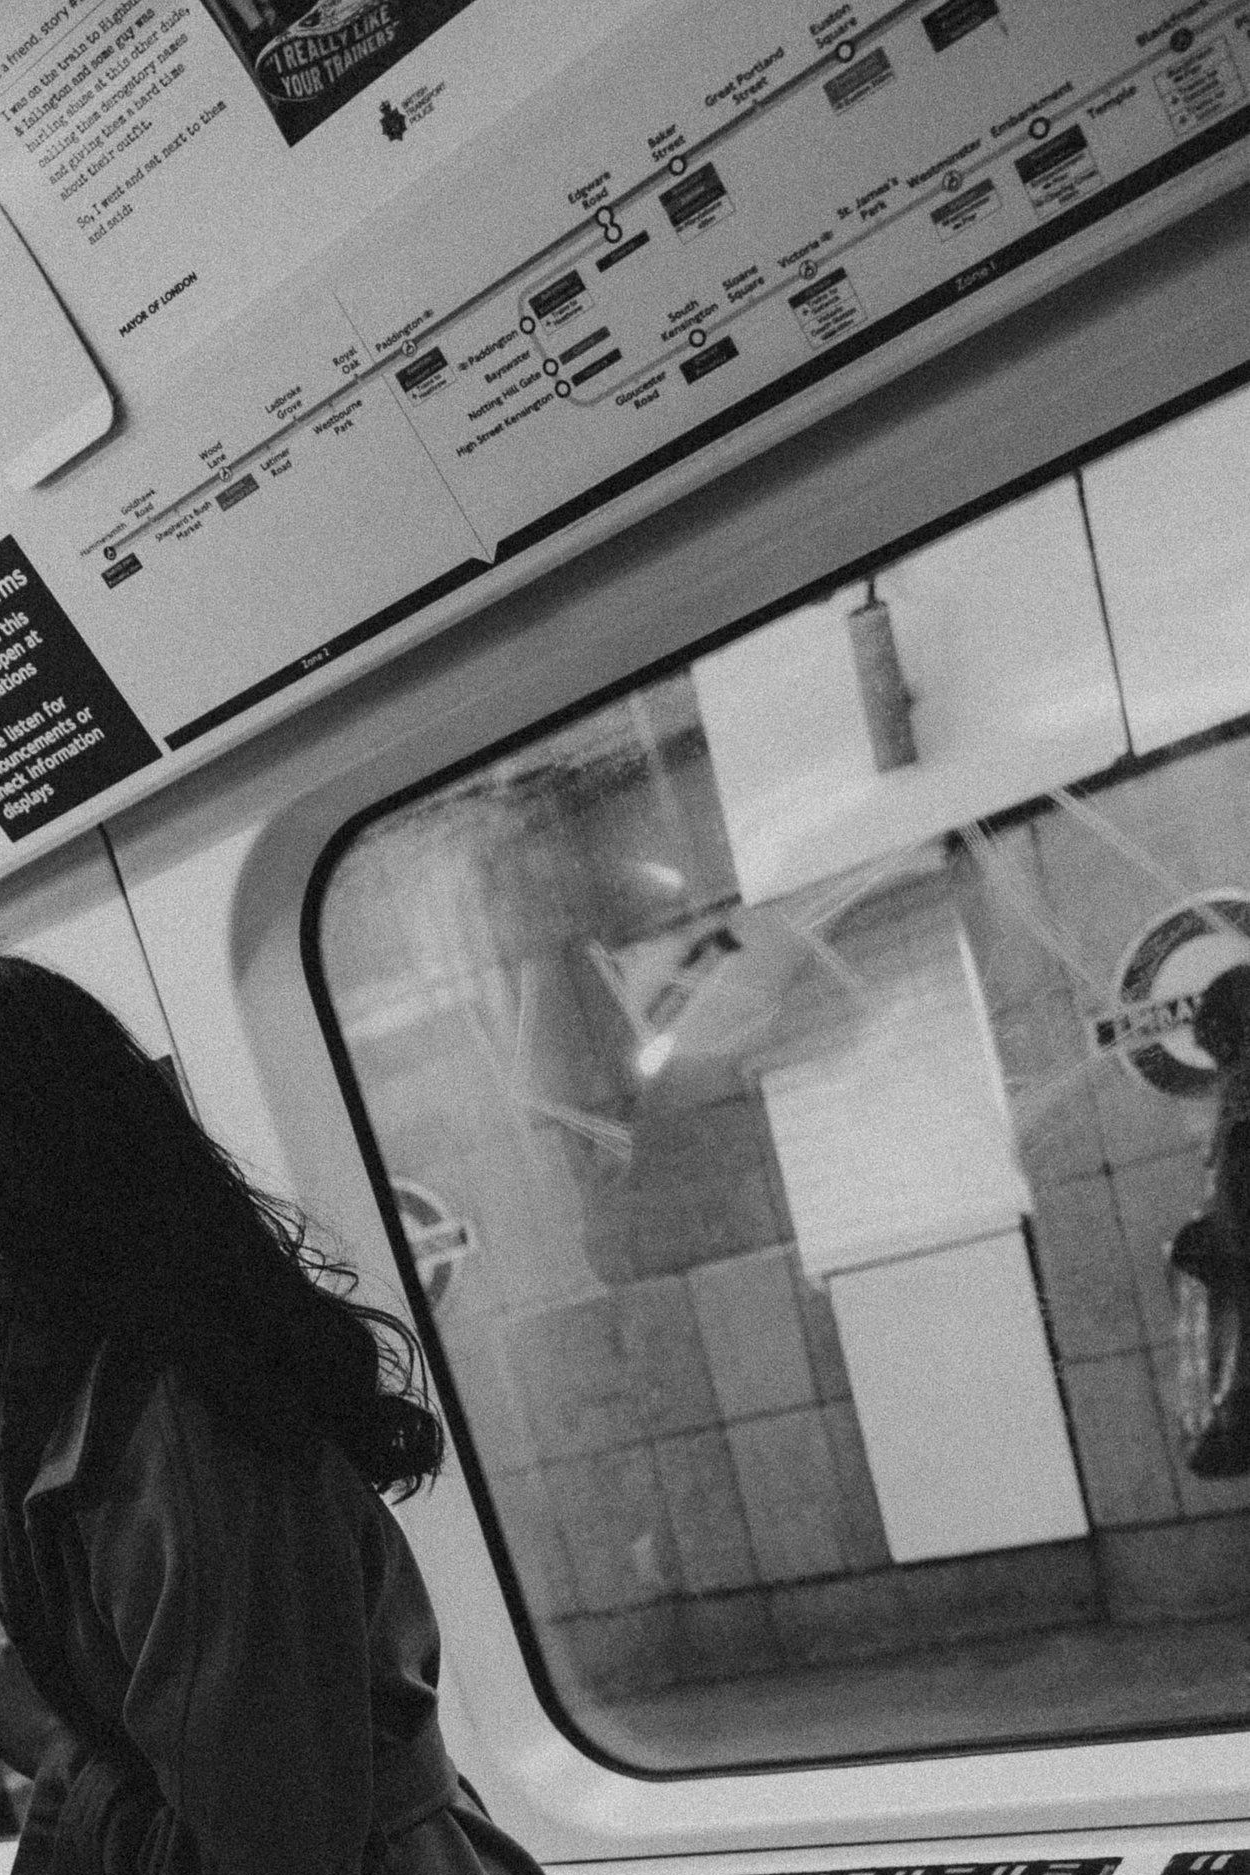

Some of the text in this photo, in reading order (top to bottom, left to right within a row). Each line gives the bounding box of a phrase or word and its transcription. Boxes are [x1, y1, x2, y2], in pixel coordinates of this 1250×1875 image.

[809, 3, 852, 36] Euston
[815, 17, 858, 50] Square
[1, 63, 10, 73] a
[40, 6, 70, 36] story
[282, 31, 347, 69] REALLY
[353, 4, 391, 40] LIKE
[0, 110, 12, 122] I
[9, 97, 27, 115] was
[28, 84, 43, 99] on
[39, 68, 59, 87] the
[56, 42, 89, 71] train
[85, 30, 101, 45] to
[21, 83, 73, 130] Islington
[71, 64, 92, 86] and
[90, 45, 115, 69] some
[115, 25, 136, 50] guy
[134, 8, 155, 28] was
[24, 7, 191, 153] hurling abuse at this other dude,
[281, 66, 324, 97] YOUR
[704, 82, 737, 107] Great
[735, 46, 785, 86] Portland
[38, 33, 188, 169] calling them derogatory names
[732, 76, 769, 106] Street
[1086, 85, 1137, 119] Temple
[49, 63, 185, 185] and giving them a hard time
[990, 81, 1074, 138] Embankment
[647, 124, 676, 149] Baker
[651, 134, 686, 162] Street
[60, 120, 153, 201] about their outfit.
[76, 100, 227, 230] So, I went and sat next to them
[906, 139, 981, 189] Westminster
[567, 171, 611, 204] Edgware
[581, 187, 609, 210] Road
[859, 200, 887, 221] Park
[88, 223, 108, 245] and
[777, 240, 821, 269] Victoria
[722, 265, 759, 291] Sloane
[727, 276, 765, 304] Square
[955, 267, 989, 292] Zone
[118, 272, 198, 337] MAYOR OF LONDON
[667, 299, 700, 324] South
[374, 316, 424, 353] Paddington
[660, 303, 719, 342] Kensington
[332, 347, 357, 367] Royal
[467, 329, 519, 366] Paddington
[341, 359, 361, 375] Oak
[484, 350, 531, 384] Bayswater
[265, 385, 302, 414] Ladbroke
[467, 371, 542, 421] Notting Hill Gate
[615, 371, 666, 406] Gloucester
[633, 389, 660, 410] Road
[276, 399, 303, 420] Grove
[313, 399, 363, 435] Westbourne
[456, 392, 554, 457] High Street Kensington
[333, 419, 354, 435] Park
[199, 441, 223, 461] Wood
[207, 453, 227, 470] Lane
[260, 448, 290, 472] Latimer
[270, 459, 292, 477] Road
[121, 488, 156, 515] Goldhawk
[134, 502, 154, 519] Road
[192, 501, 212, 517] Bush
[176, 520, 202, 540] Market
[24, 630, 43, 649] at
[301, 652, 324, 670] Zone
[3, 711, 46, 742] listen
[41, 696, 67, 718] for
[76, 706, 93, 724] or
[25, 727, 105, 780] information
[2, 783, 55, 820] displays
